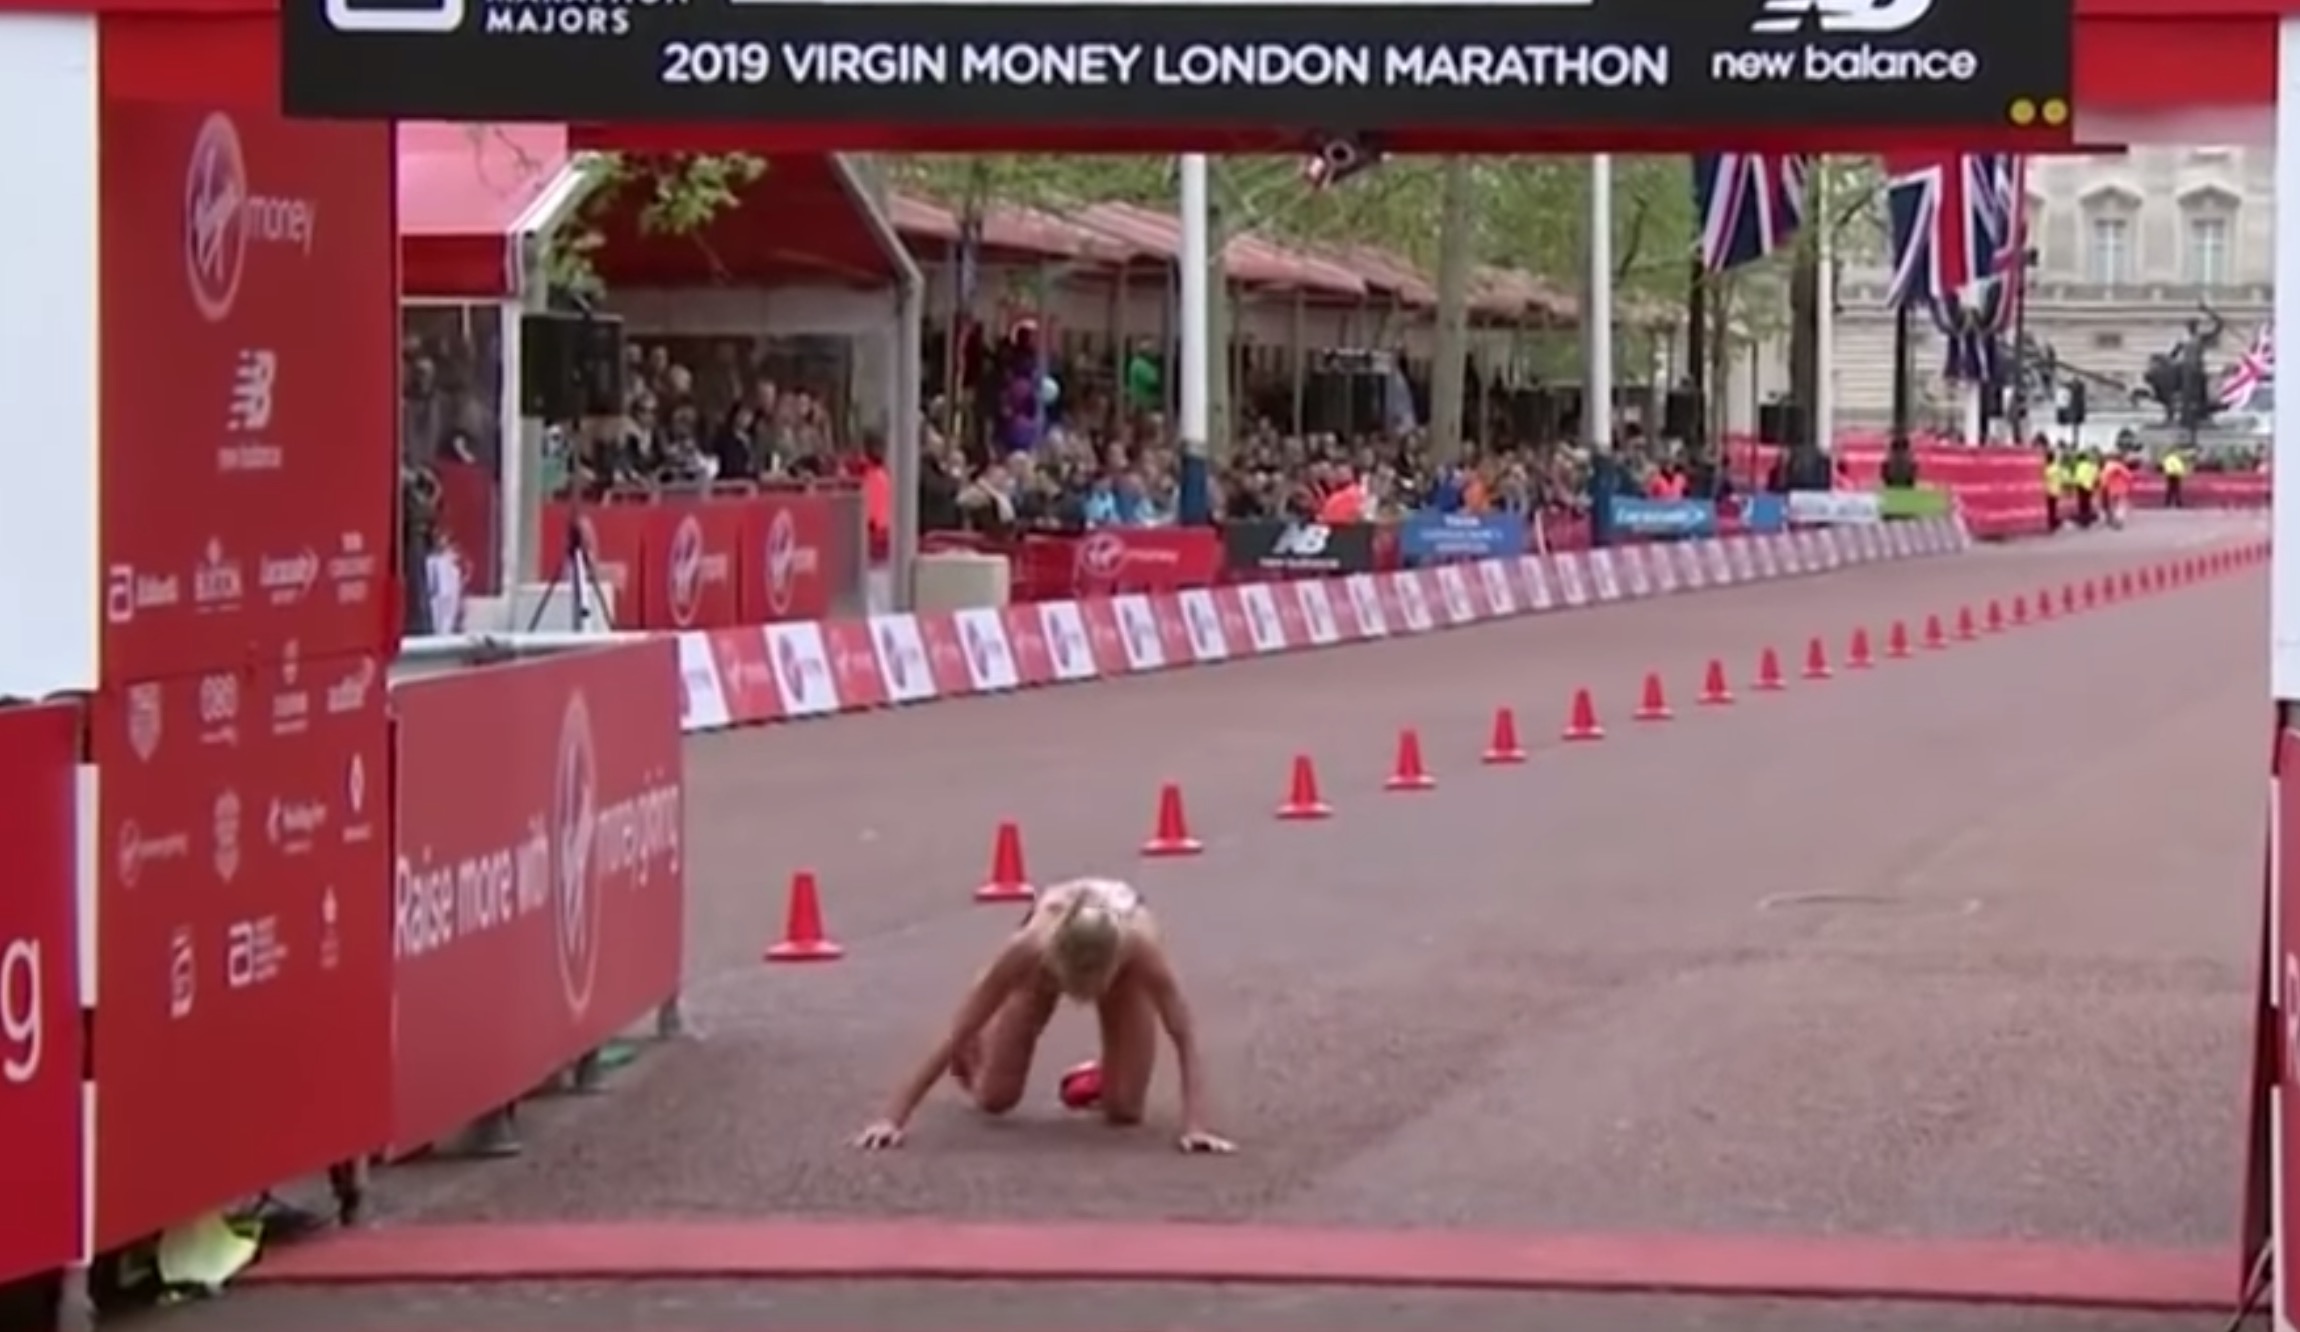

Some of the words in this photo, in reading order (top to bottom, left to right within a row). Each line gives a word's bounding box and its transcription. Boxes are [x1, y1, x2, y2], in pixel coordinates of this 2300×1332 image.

[486, 7, 629, 34] MAJORS
[663, 43, 769, 82] 2019
[783, 43, 946, 82] VIRGIN
[961, 44, 1141, 83] MONEY
[1155, 44, 1369, 84] LONDON
[1386, 45, 1668, 85] MARATHON
[1712, 50, 1796, 80] new
[1804, 42, 1978, 80] balance
[248, 196, 316, 254] money
[394, 845, 452, 958] Raise
[458, 847, 512, 936] more
